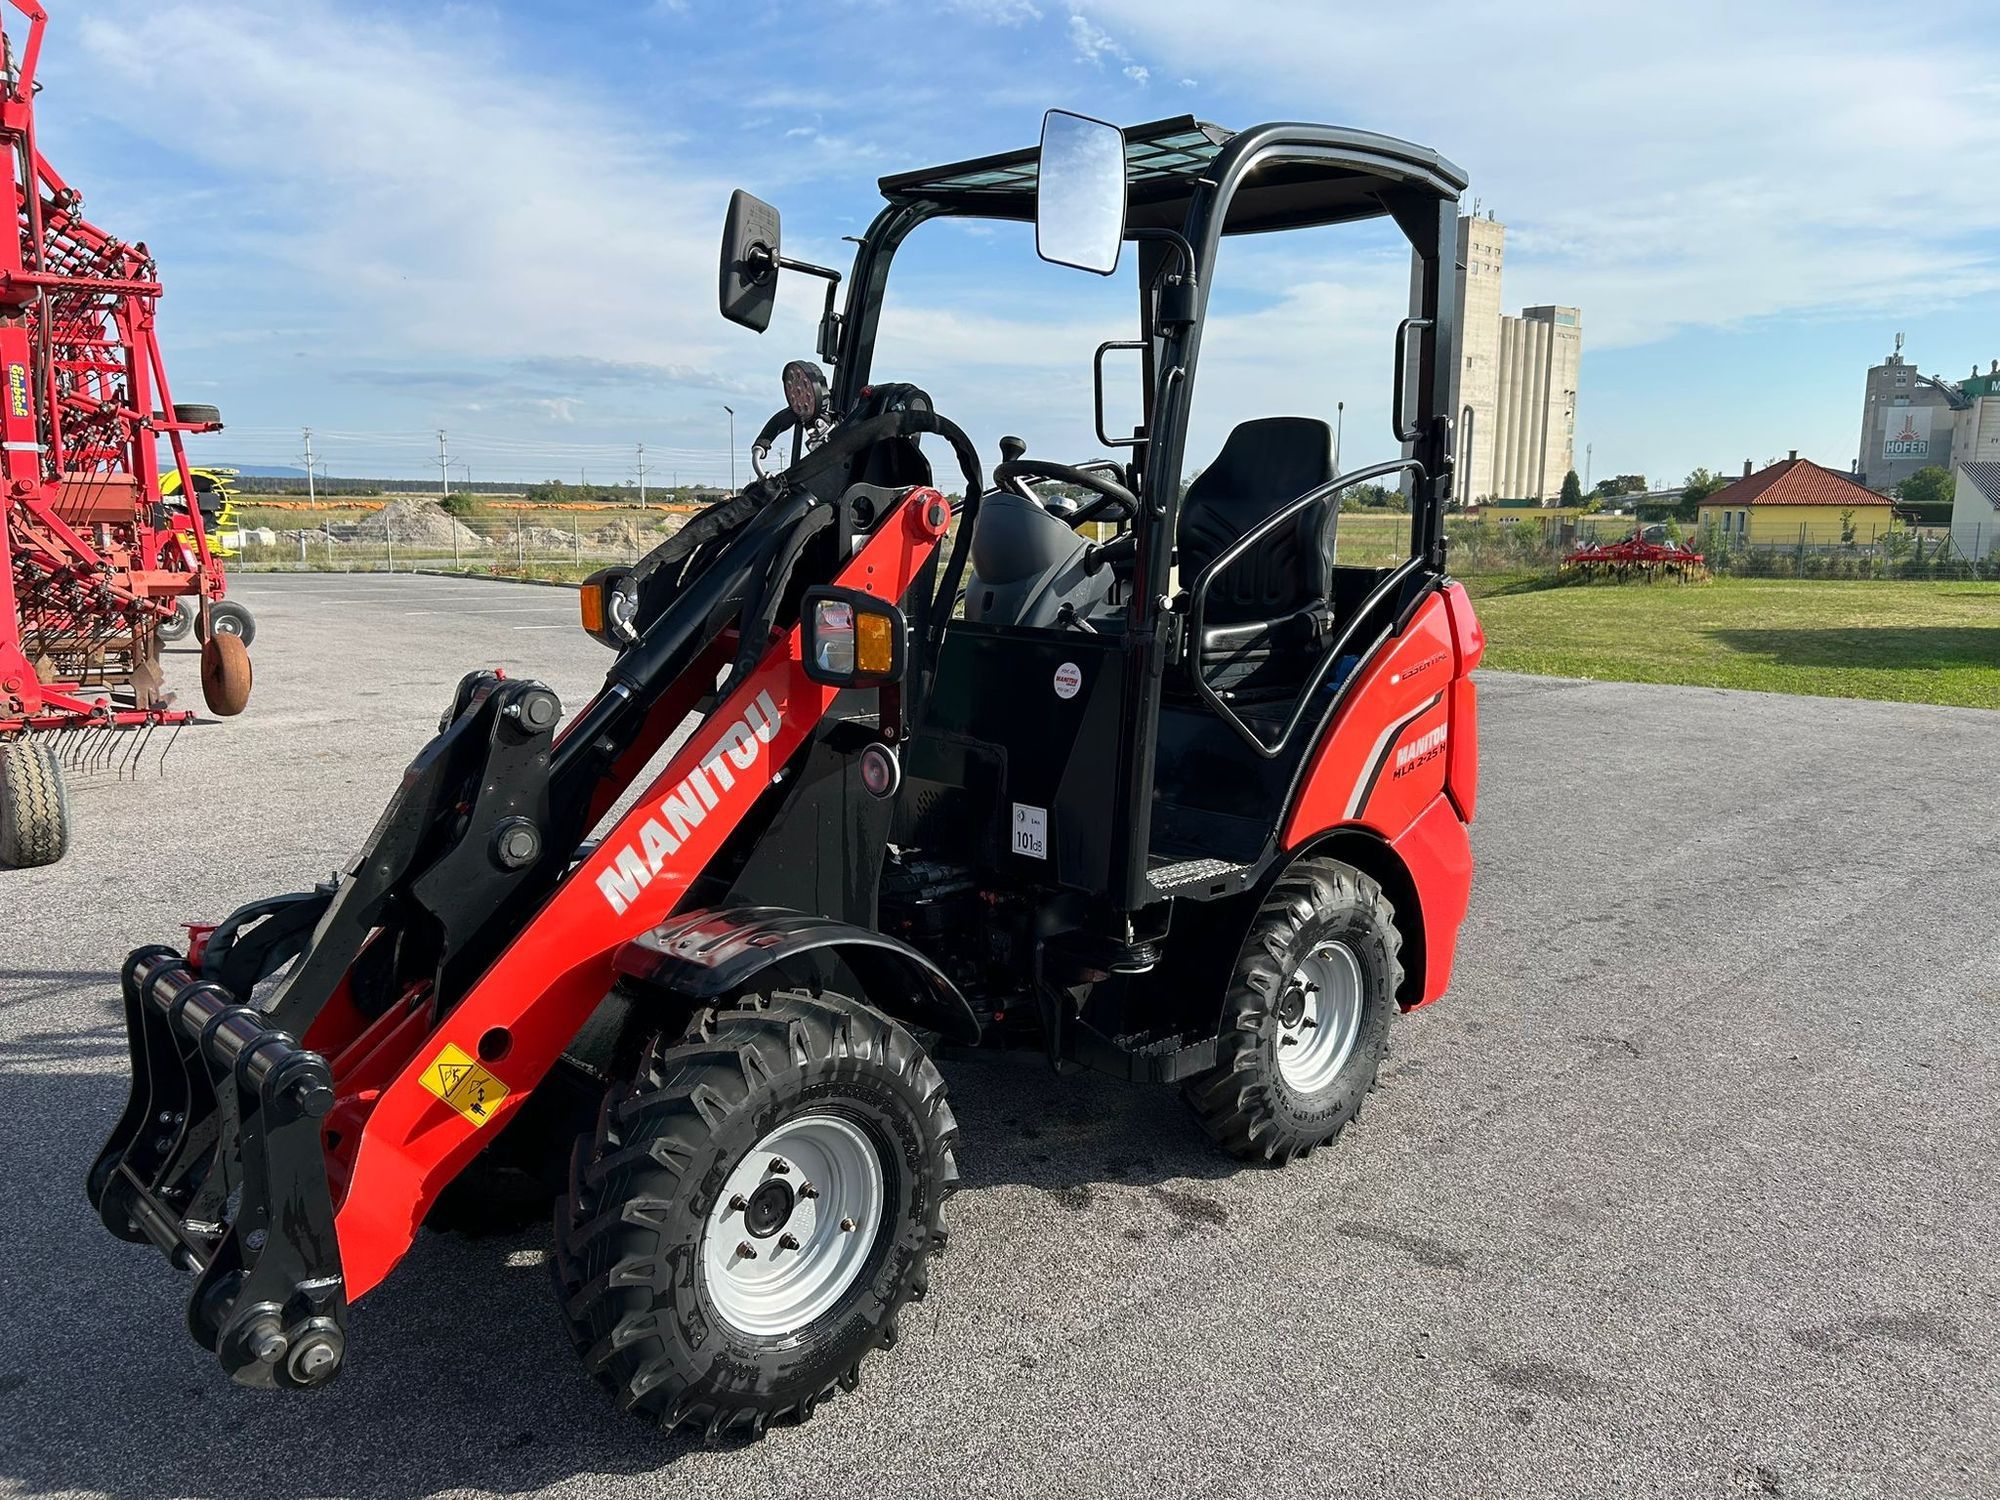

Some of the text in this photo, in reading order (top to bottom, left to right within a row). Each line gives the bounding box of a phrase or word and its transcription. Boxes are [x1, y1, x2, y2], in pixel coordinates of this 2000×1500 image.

[1886, 441, 1927, 453] HOFER
[1393, 742, 1446, 781] MLA 2-25 H
[1396, 721, 1448, 768] MANITOU
[595, 688, 782, 916] MANITOU
